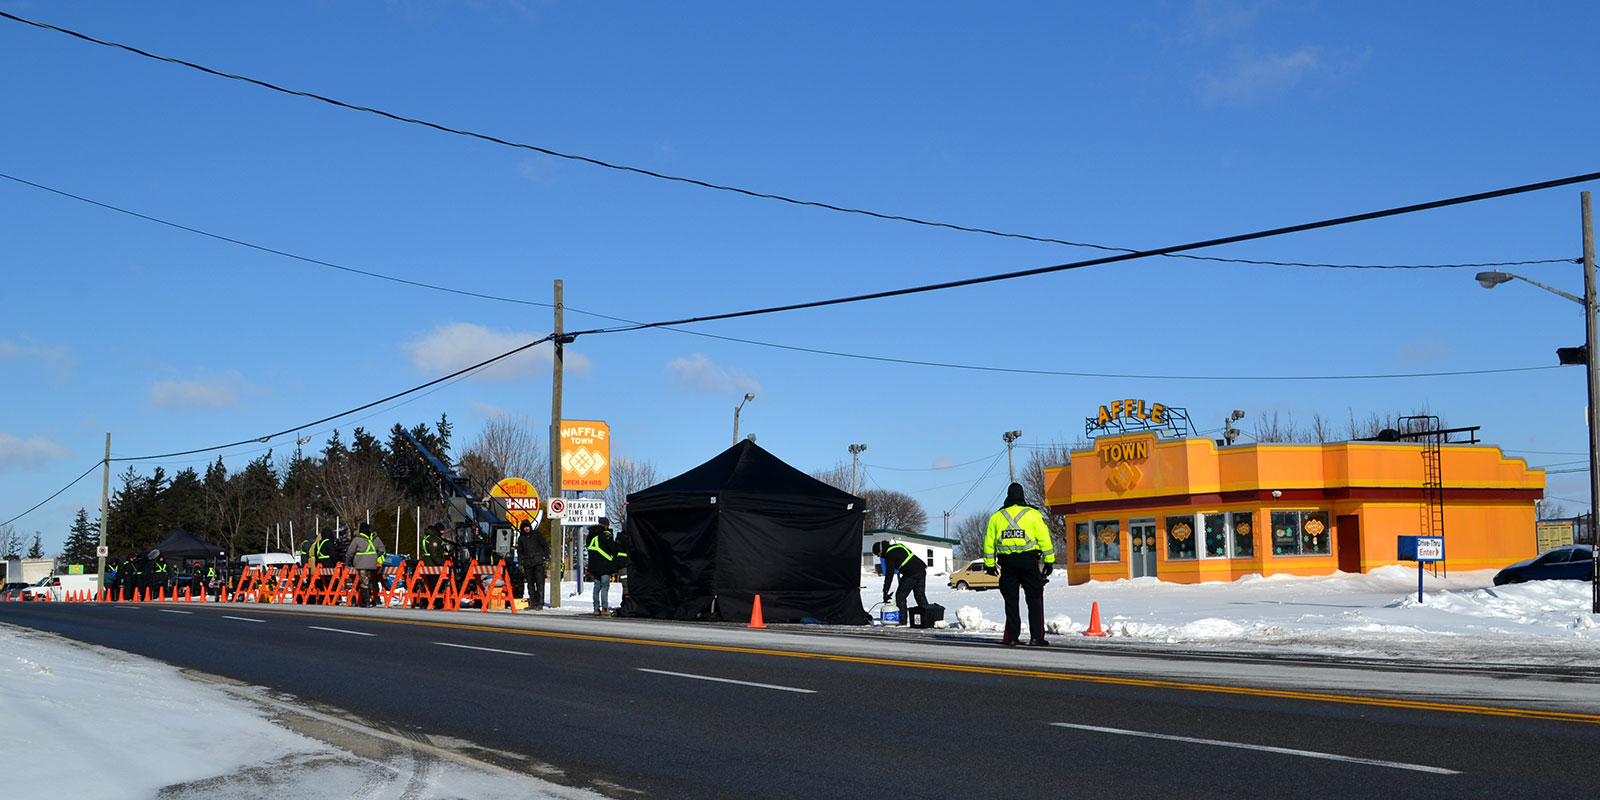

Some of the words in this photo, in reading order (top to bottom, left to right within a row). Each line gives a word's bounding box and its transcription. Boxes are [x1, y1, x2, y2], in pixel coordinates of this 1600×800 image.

[1098, 399, 1166, 425] AFFLE
[561, 427, 605, 440] WAFFLE
[570, 437, 594, 445] TOWN
[1101, 440, 1149, 463] TOWN
[501, 482, 528, 495] Family
[567, 502, 603, 510] REAKFAST
[1003, 530, 1024, 538] POLICE
[1417, 539, 1441, 547] Drive-Thru
[1419, 548, 1435, 556] Enter
